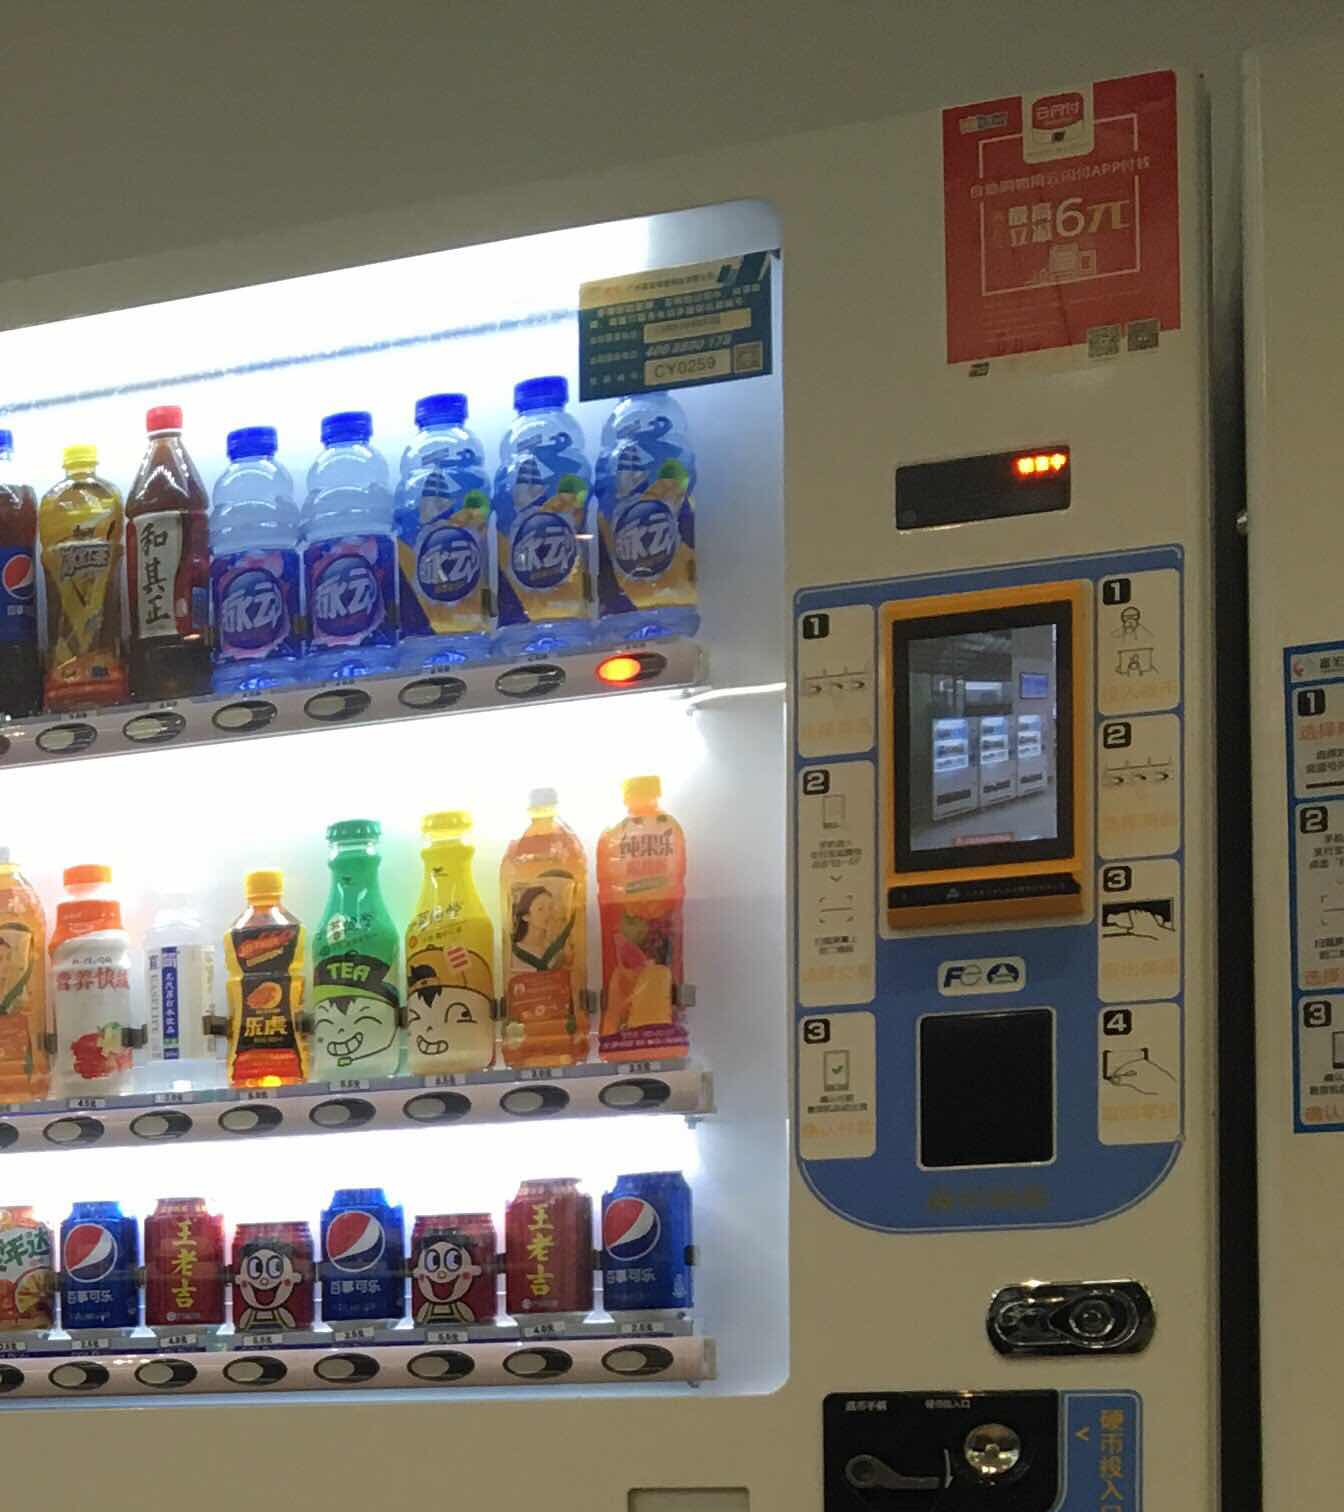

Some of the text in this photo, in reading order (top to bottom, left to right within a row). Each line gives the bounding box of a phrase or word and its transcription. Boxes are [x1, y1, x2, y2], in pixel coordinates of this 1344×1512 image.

[140, 522, 171, 625] 和其正
[1107, 725, 1126, 746] 2
[806, 772, 826, 792] 2
[1305, 809, 1324, 832] 2
[1107, 870, 1126, 888] 3
[326, 962, 369, 980] TEA
[1106, 1013, 1128, 1032] 4
[1309, 1003, 1326, 1025] 3
[807, 1021, 825, 1039] 3
[526, 1202, 557, 1297] 王老吉
[171, 1219, 199, 1309] 王老吉
[67, 1289, 112, 1305] 百事可乐
[329, 1279, 381, 1296] 百事可乐
